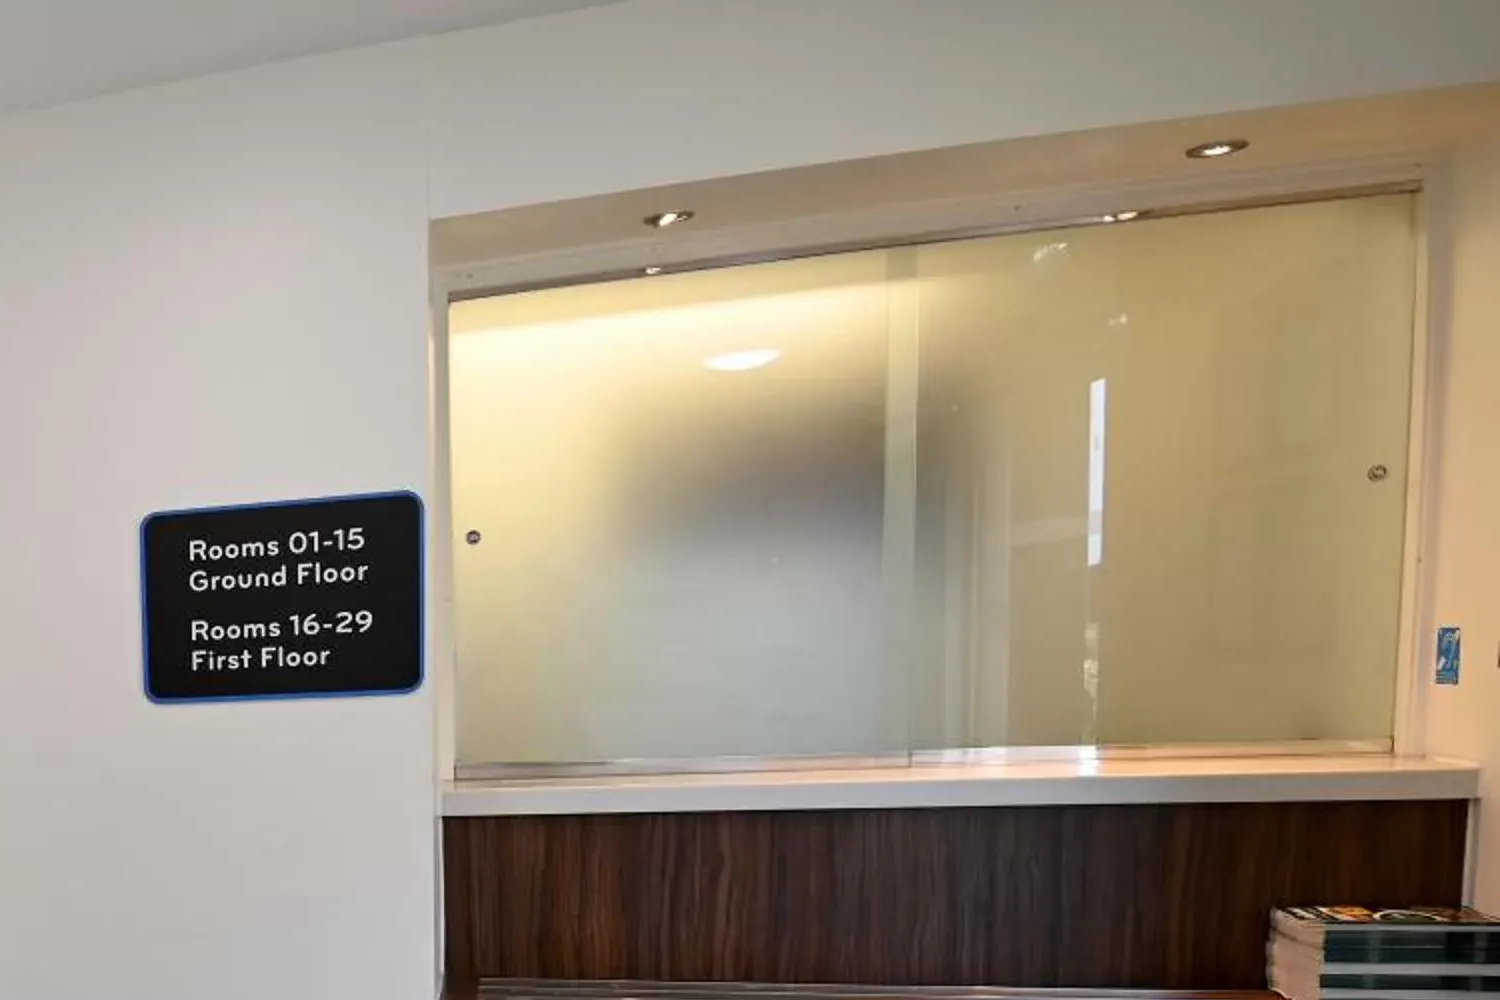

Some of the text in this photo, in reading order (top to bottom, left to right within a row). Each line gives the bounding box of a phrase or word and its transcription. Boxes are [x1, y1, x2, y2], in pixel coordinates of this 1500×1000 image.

[189, 527, 366, 562] Rooms 01-15
[189, 561, 370, 592] Ground Floor
[191, 610, 374, 642] Rooms 16-29
[192, 646, 331, 672] First Floor
